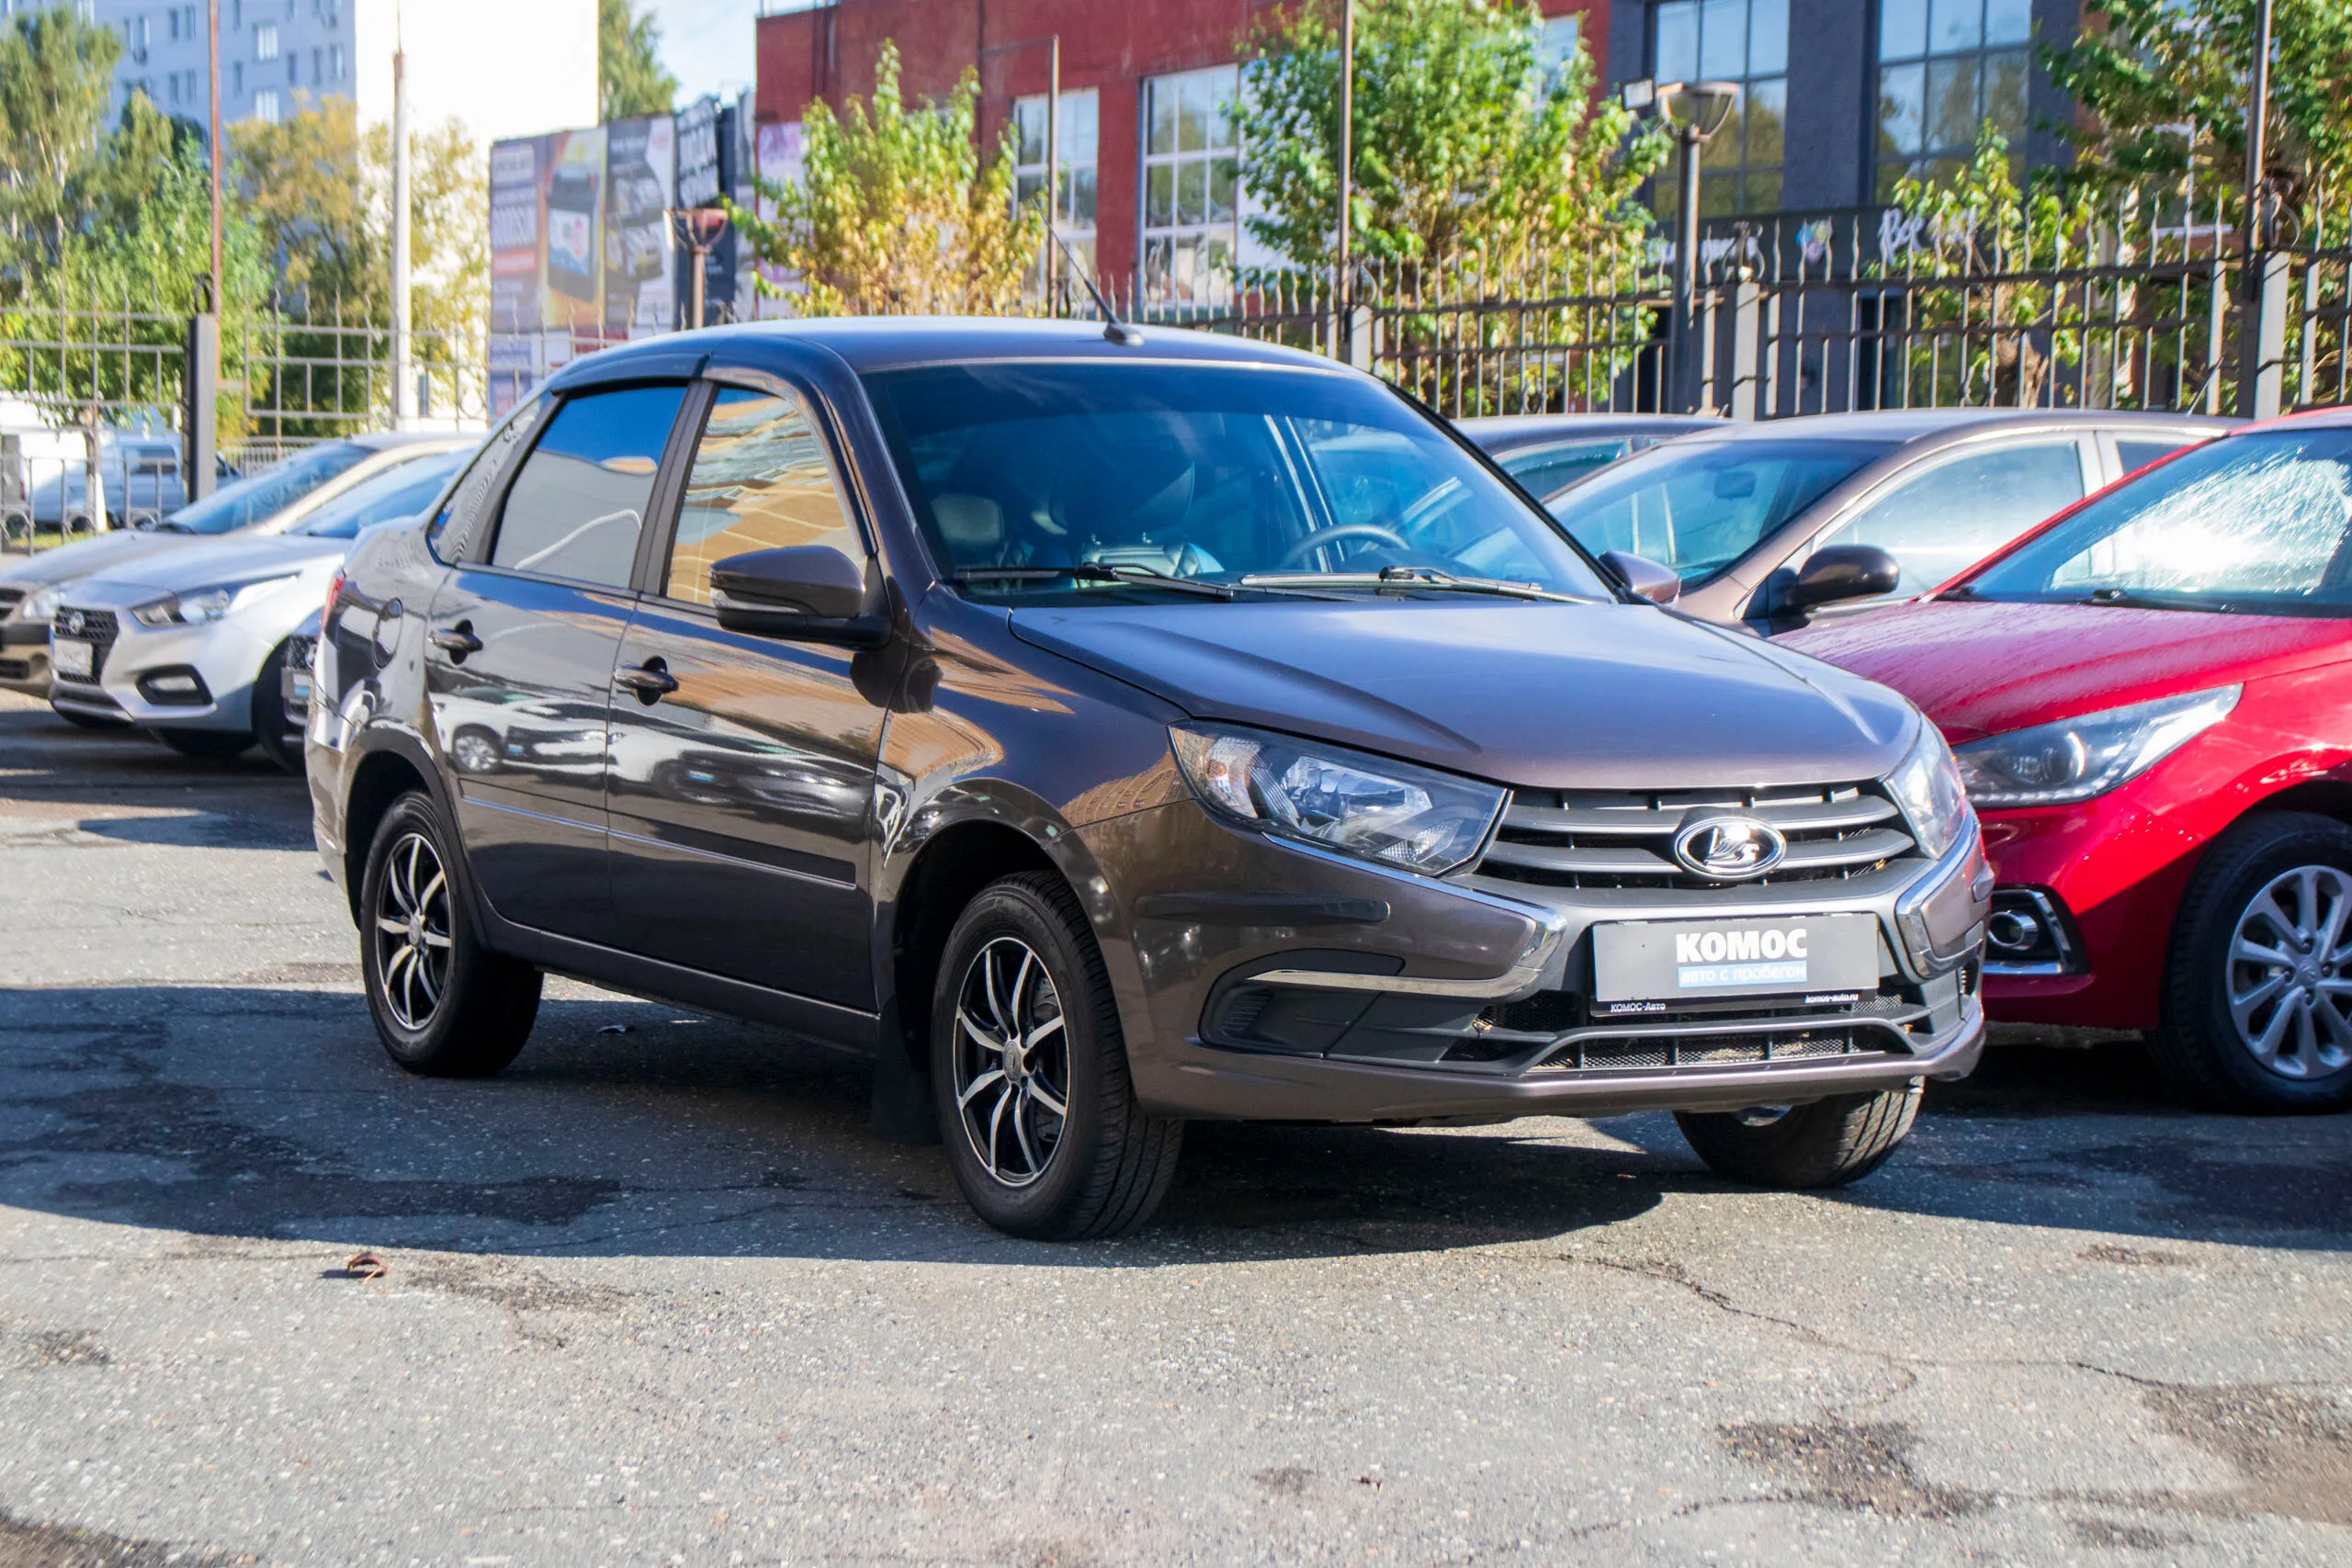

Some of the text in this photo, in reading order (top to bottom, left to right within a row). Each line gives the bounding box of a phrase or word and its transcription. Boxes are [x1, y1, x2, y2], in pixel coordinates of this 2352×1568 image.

[1676, 929, 1807, 963] КОМОС
[1681, 964, 1805, 983] авто с пробегом
[1805, 993, 1860, 1003] komos-auto.ru
[1611, 1002, 1667, 1012] КОМОС-Авто
